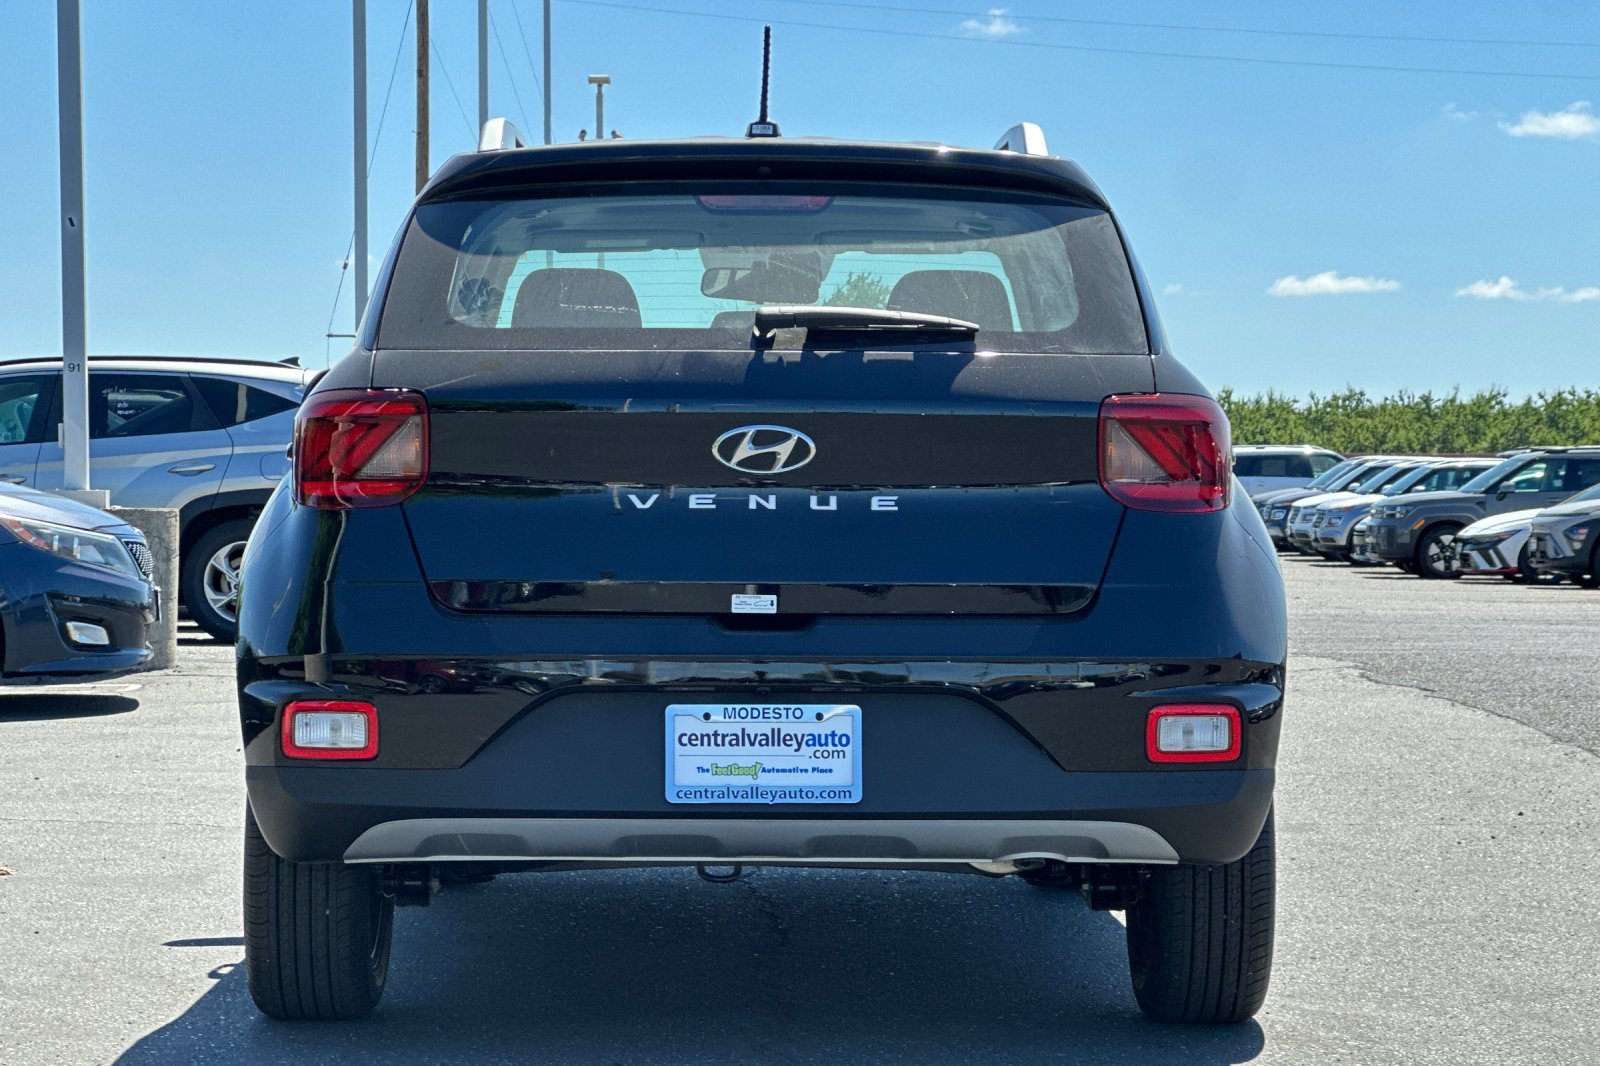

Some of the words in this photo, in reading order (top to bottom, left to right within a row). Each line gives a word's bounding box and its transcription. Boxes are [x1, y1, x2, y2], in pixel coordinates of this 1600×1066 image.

[68, 362, 80, 372] 91
[627, 494, 899, 511] VENUE
[723, 707, 804, 720] MODESTO
[677, 727, 851, 752] centralvalleyauto
[808, 749, 846, 759] .com
[697, 766, 710, 774] The
[761, 766, 809, 774] Automotive
[811, 766, 833, 774] Place
[676, 787, 852, 802] centralvalleyauto.com
